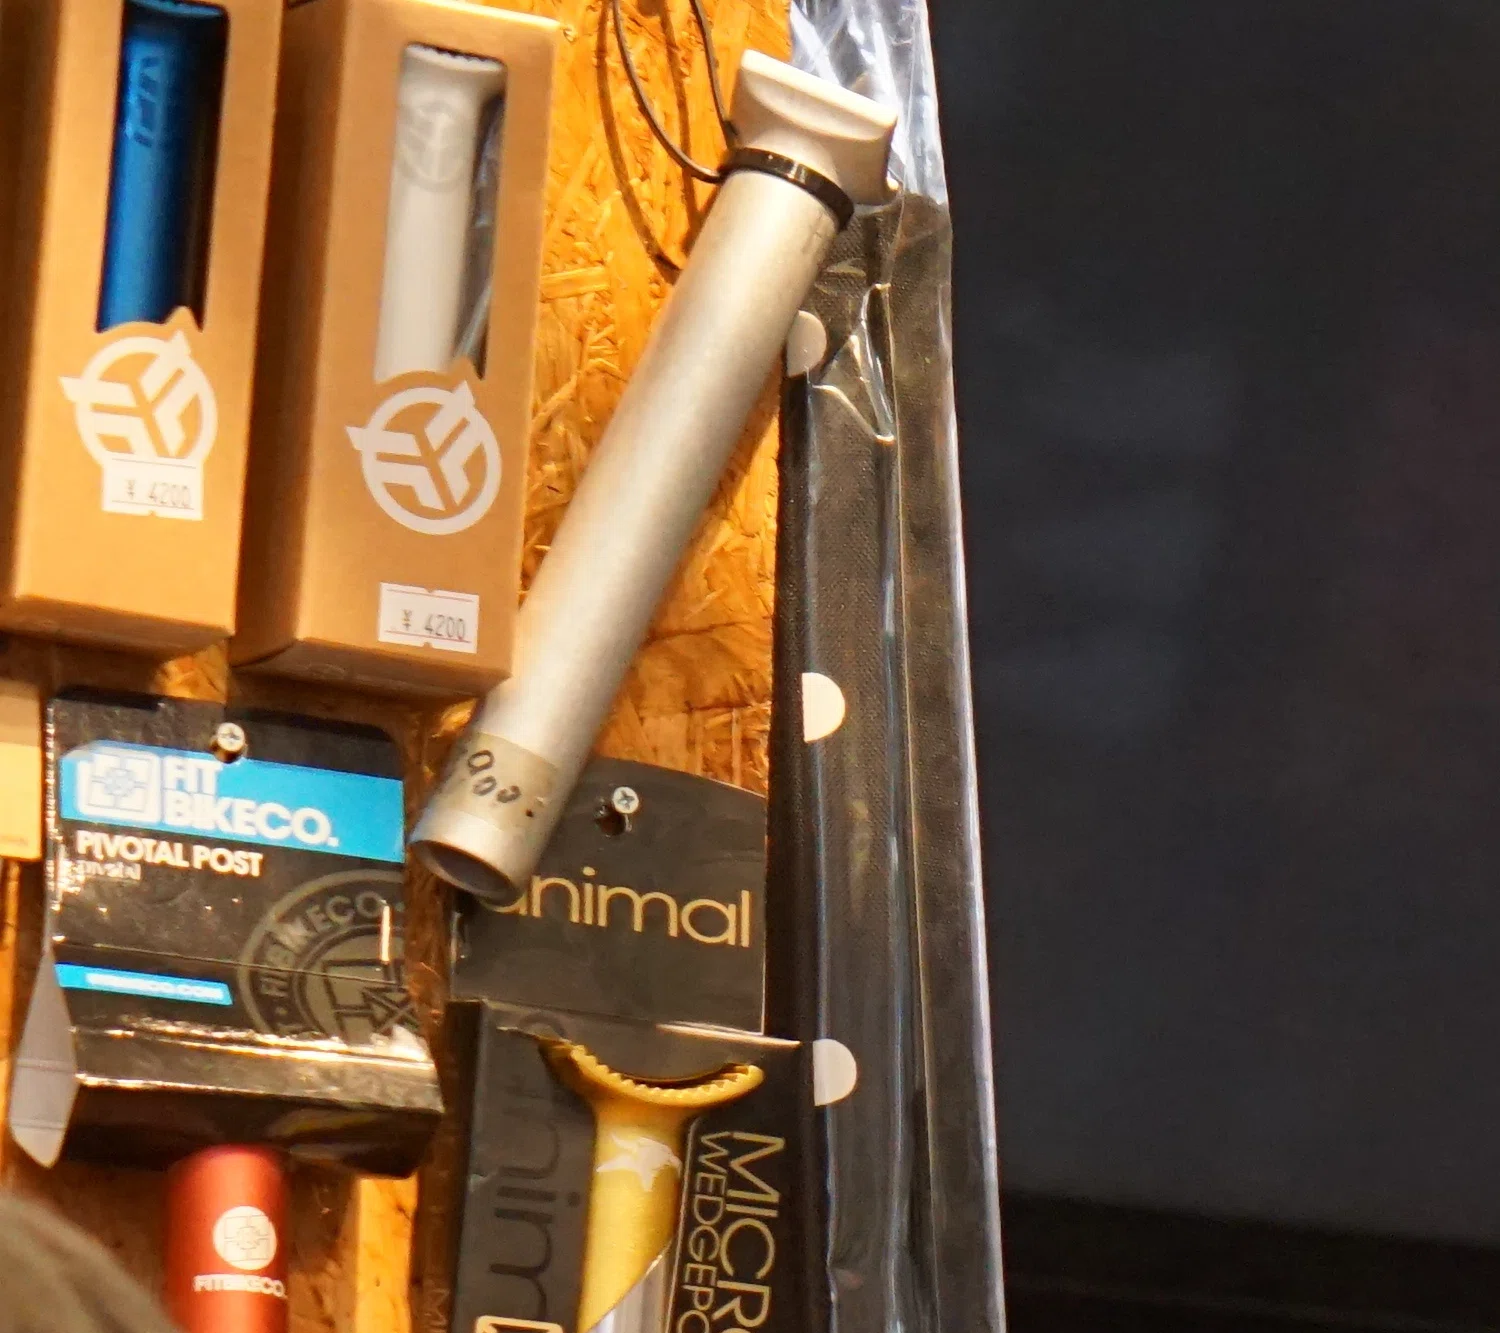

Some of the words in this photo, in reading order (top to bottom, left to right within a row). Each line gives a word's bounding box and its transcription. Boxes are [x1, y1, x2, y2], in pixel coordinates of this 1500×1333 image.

[423, 613, 467, 641] 4200
[163, 757, 223, 795] FIT
[75, 830, 190, 869] PIVOTAL
[193, 845, 264, 877] POST
[483, 866, 750, 948] nimal
